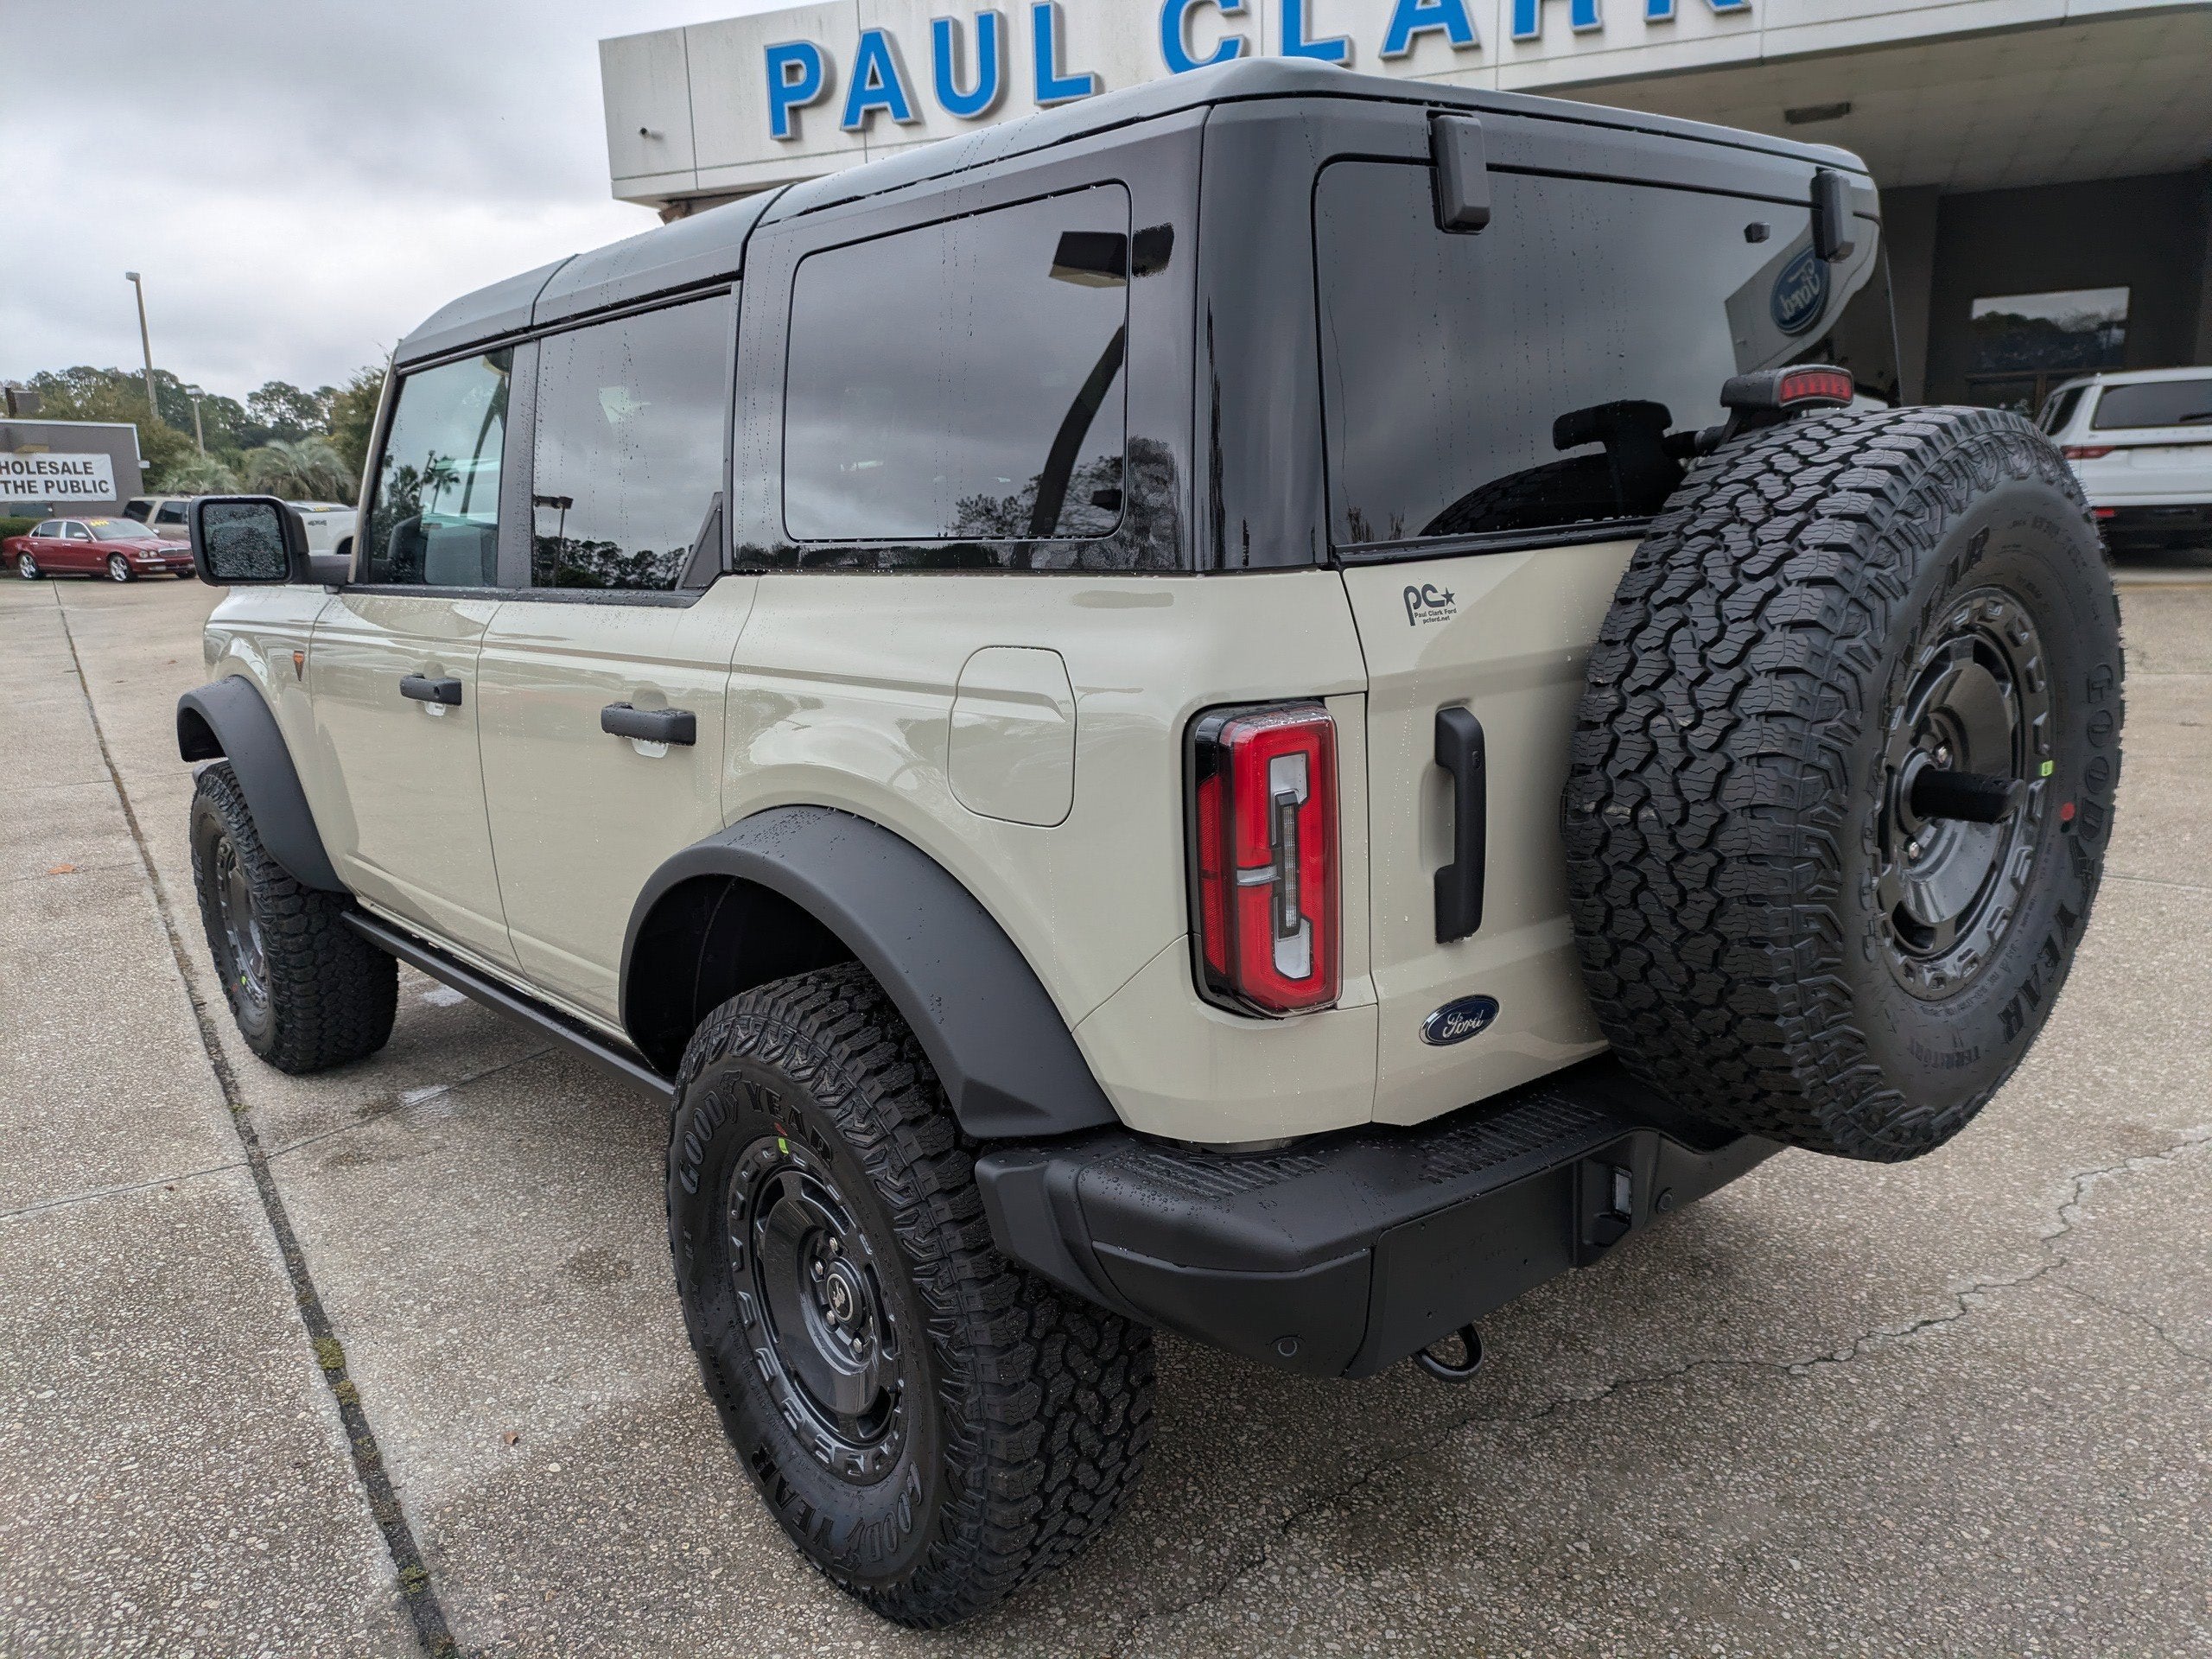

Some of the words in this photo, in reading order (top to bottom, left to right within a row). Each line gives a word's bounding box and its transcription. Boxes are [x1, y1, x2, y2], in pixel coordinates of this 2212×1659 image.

[765, 2, 1097, 141] PAUL
[1160, 0, 1751, 75] CLA
[0, 461, 94, 475] HOLESALE
[0, 480, 39, 494] THE
[44, 480, 111, 494] PUBLIC
[1442, 1009, 1484, 1038] Ford
